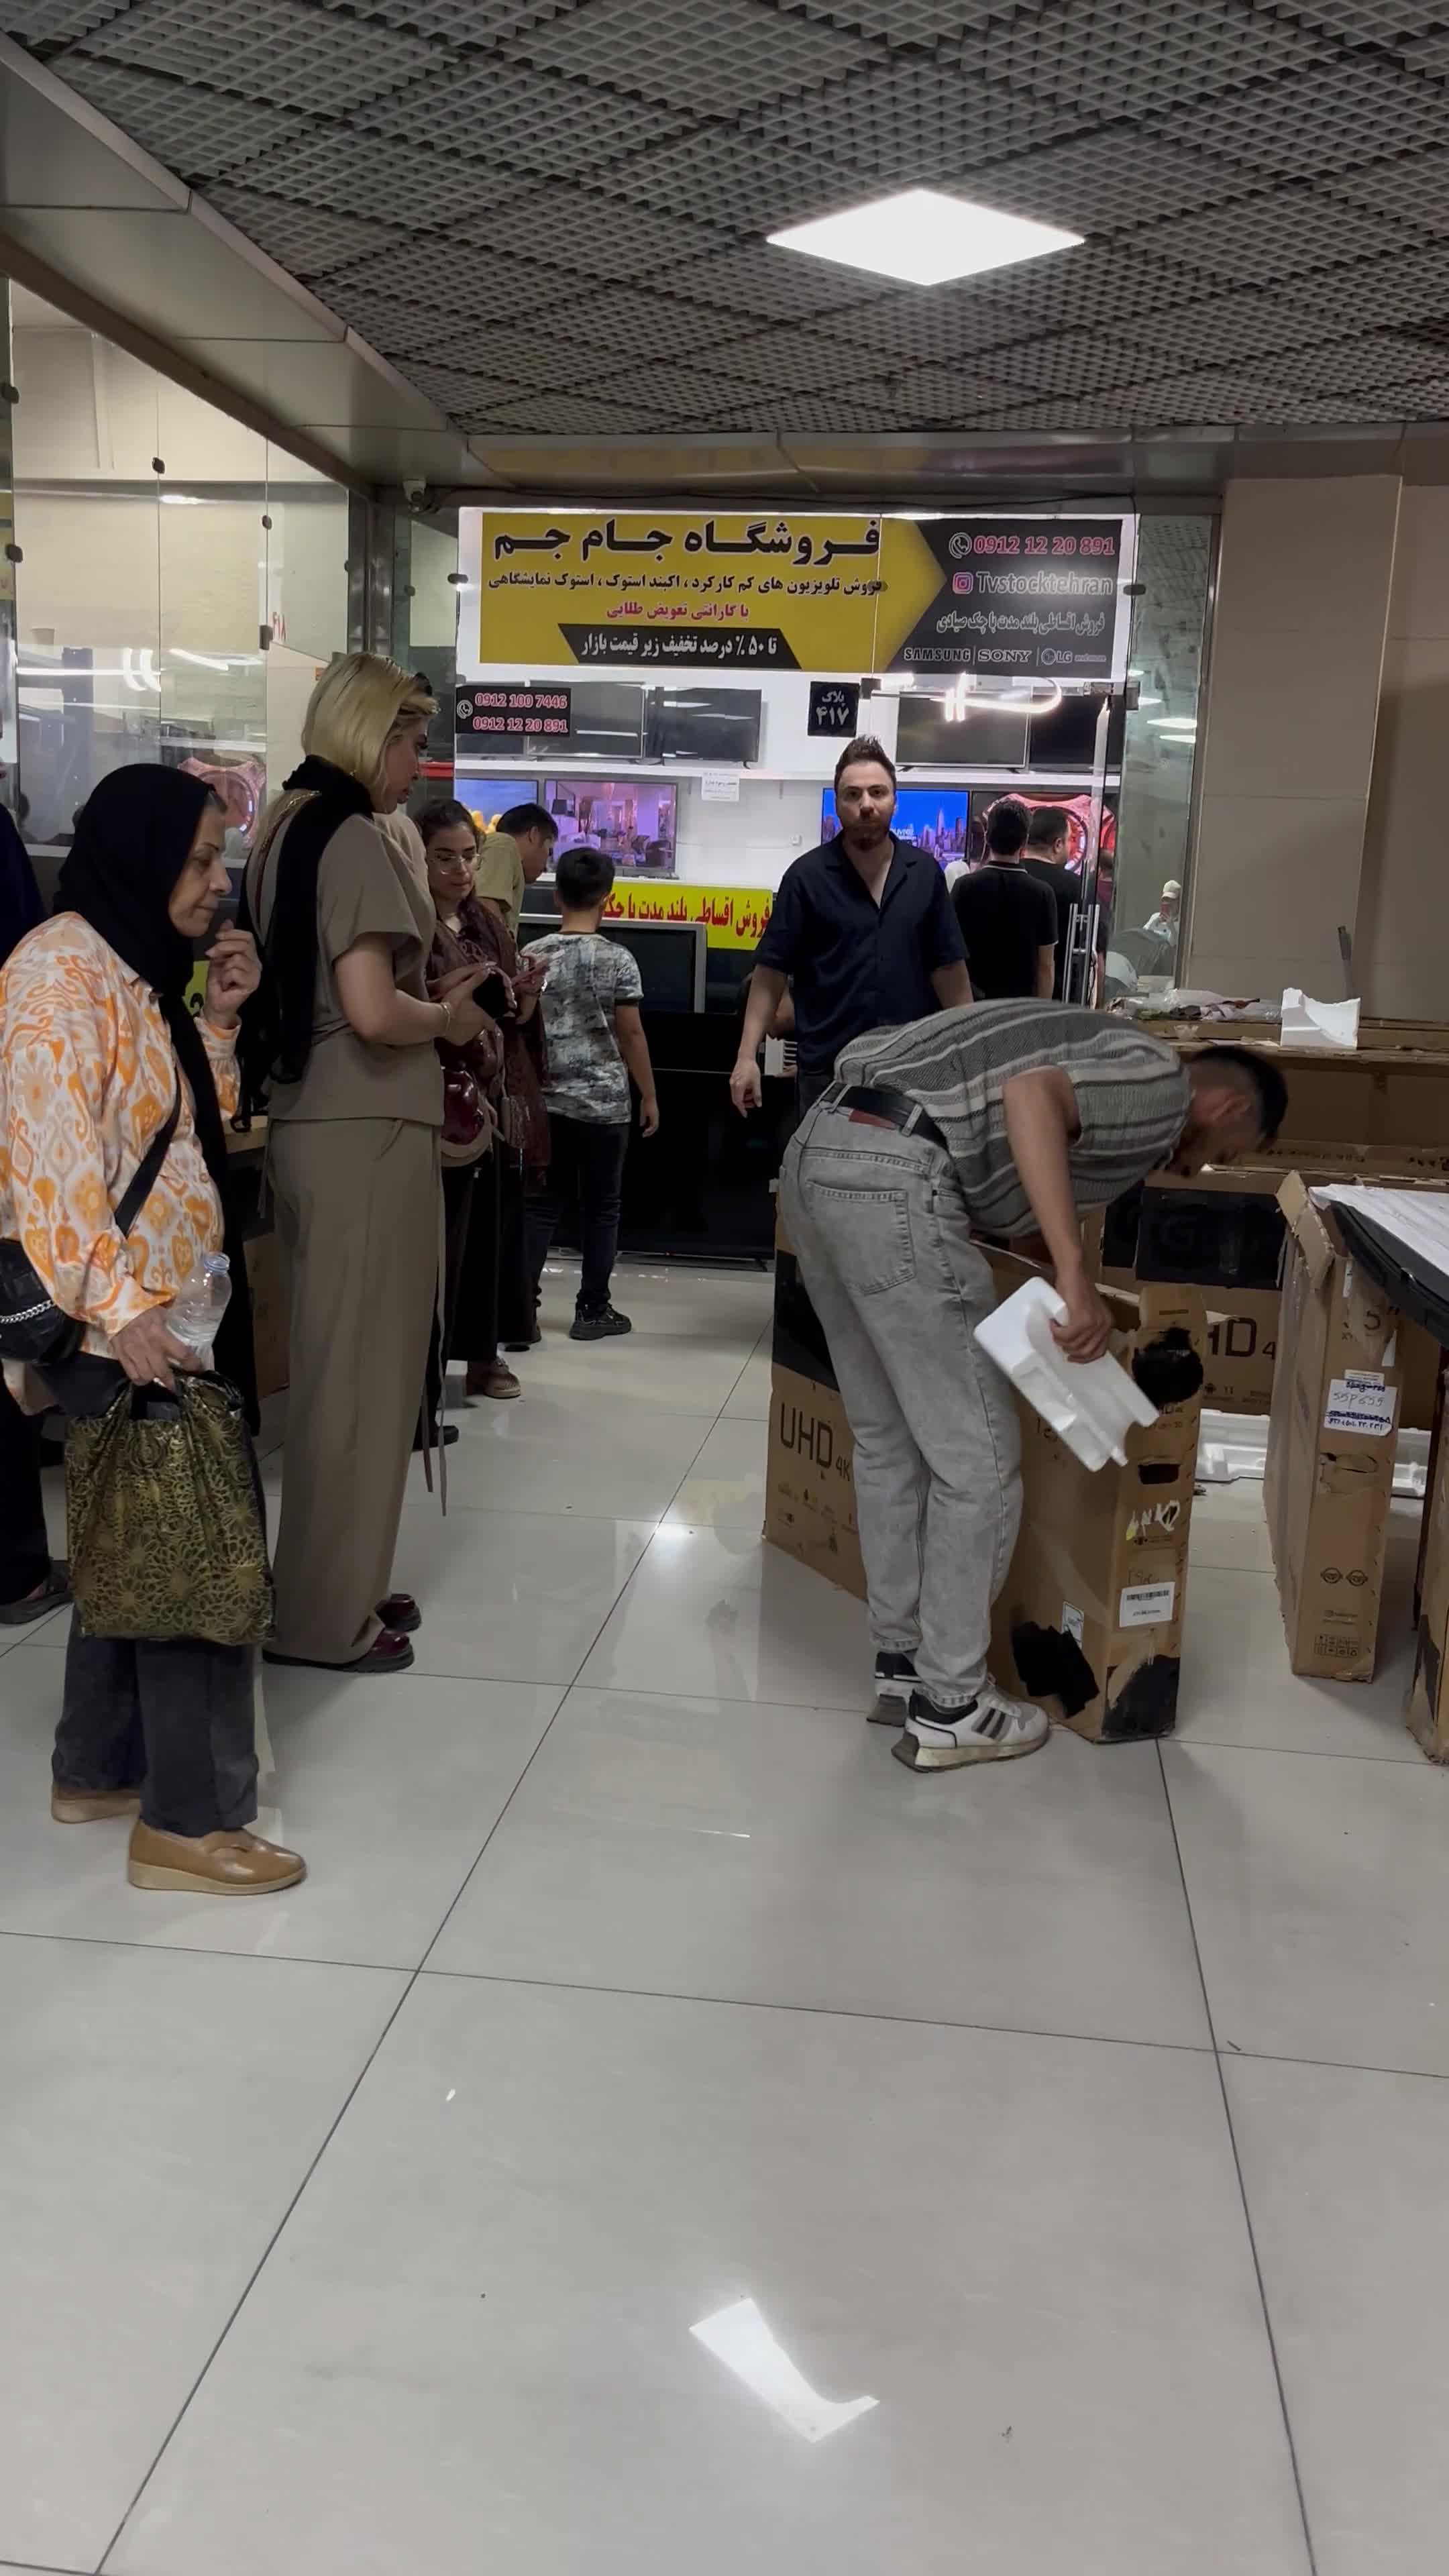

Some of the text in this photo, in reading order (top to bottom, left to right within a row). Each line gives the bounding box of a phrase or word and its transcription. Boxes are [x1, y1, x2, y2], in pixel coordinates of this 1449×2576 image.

[494, 519, 881, 566] فروشگاه جام جم
[973, 535, 1116, 555] 0912 12 20 891
[554, 572, 594, 590] استوک
[606, 574, 646, 591] استوک
[649, 574, 680, 592] اکبند
[738, 576, 754, 593] کم
[758, 576, 783, 594] های
[787, 576, 840, 595] تلویزیون
[843, 577, 882, 596] فروش
[976, 570, 1113, 595] Tvstocktehran
[647, 602, 688, 620] تعویض
[740, 603, 749, 621] با
[967, 610, 988, 635] چک
[988, 610, 996, 634] با
[997, 614, 1020, 630] مدت
[1020, 611, 1039, 634] بلند
[1039, 611, 1075, 635] اقساطی
[1075, 612, 1106, 636] فروش
[581, 633, 607, 655] بازار
[609, 633, 639, 655] قیمت
[641, 638, 659, 657] زیر
[661, 635, 698, 657] تخفیف
[700, 639, 733, 659] درصد
[767, 637, 777, 655] تا
[904, 647, 971, 663] SAMSUNG
[978, 648, 1032, 663] SONY
[1057, 650, 1073, 664] LG
[475, 692, 568, 709] 0912 100 7446
[821, 690, 846, 708] پلاک
[473, 716, 568, 733] 0912 12 20 891
[816, 706, 849, 725] ۴۱۷
[736, 897, 770, 938] فروش
[780, 1402, 851, 1482] UHD 4K
